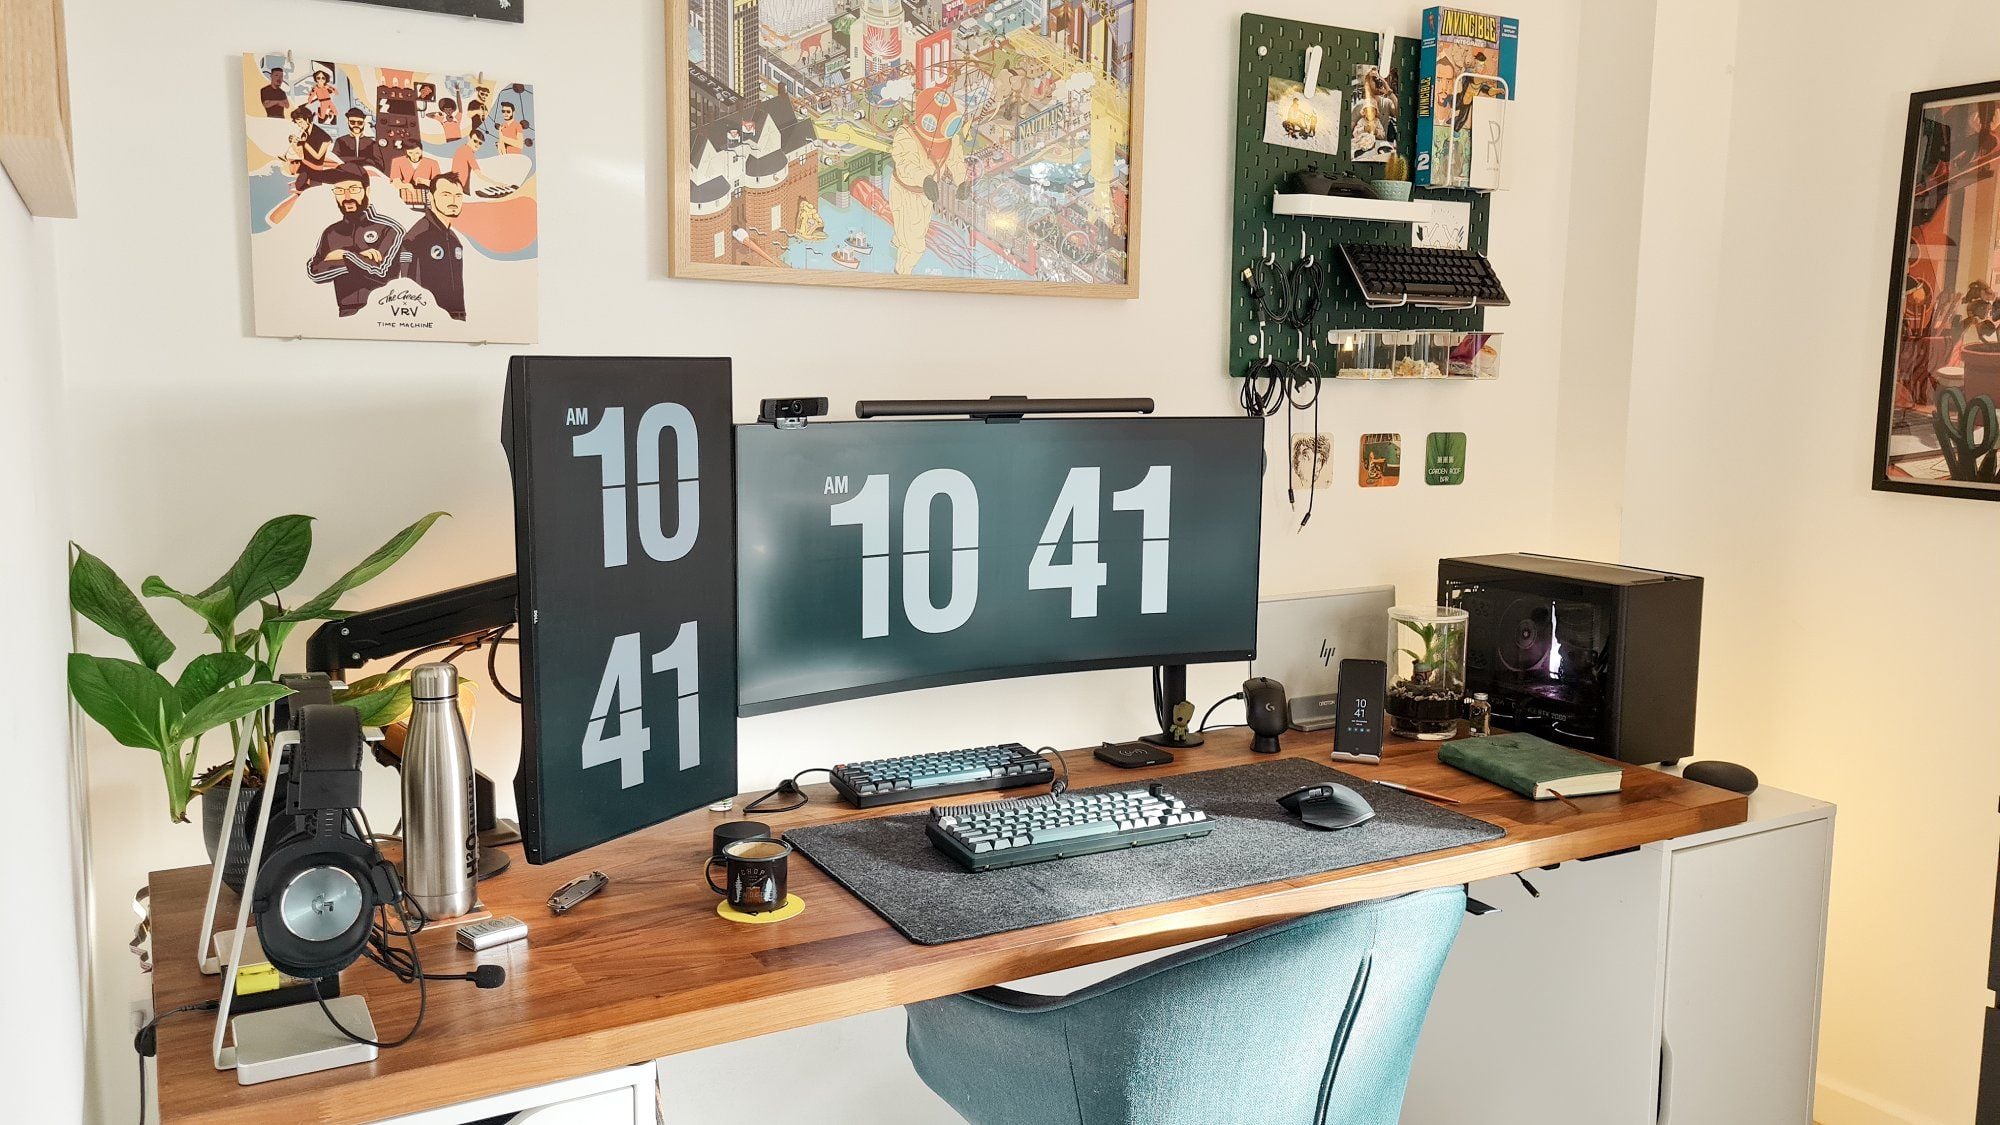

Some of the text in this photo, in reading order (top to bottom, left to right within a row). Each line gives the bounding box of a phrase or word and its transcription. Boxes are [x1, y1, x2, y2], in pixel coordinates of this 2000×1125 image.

[1441, 9, 1497, 44] INVINCIBLE
[688, 67, 738, 103] USTICE
[1019, 106, 1063, 140] NAUTILUS
[1416, 153, 1430, 171] 2
[391, 305, 418, 317] VRV
[397, 290, 427, 306] Geek
[566, 402, 700, 568] AM 10
[823, 465, 1172, 639] AM 10 41
[581, 620, 701, 790] 41
[1353, 708, 1366, 718] 41
[1355, 698, 1367, 709] 10
